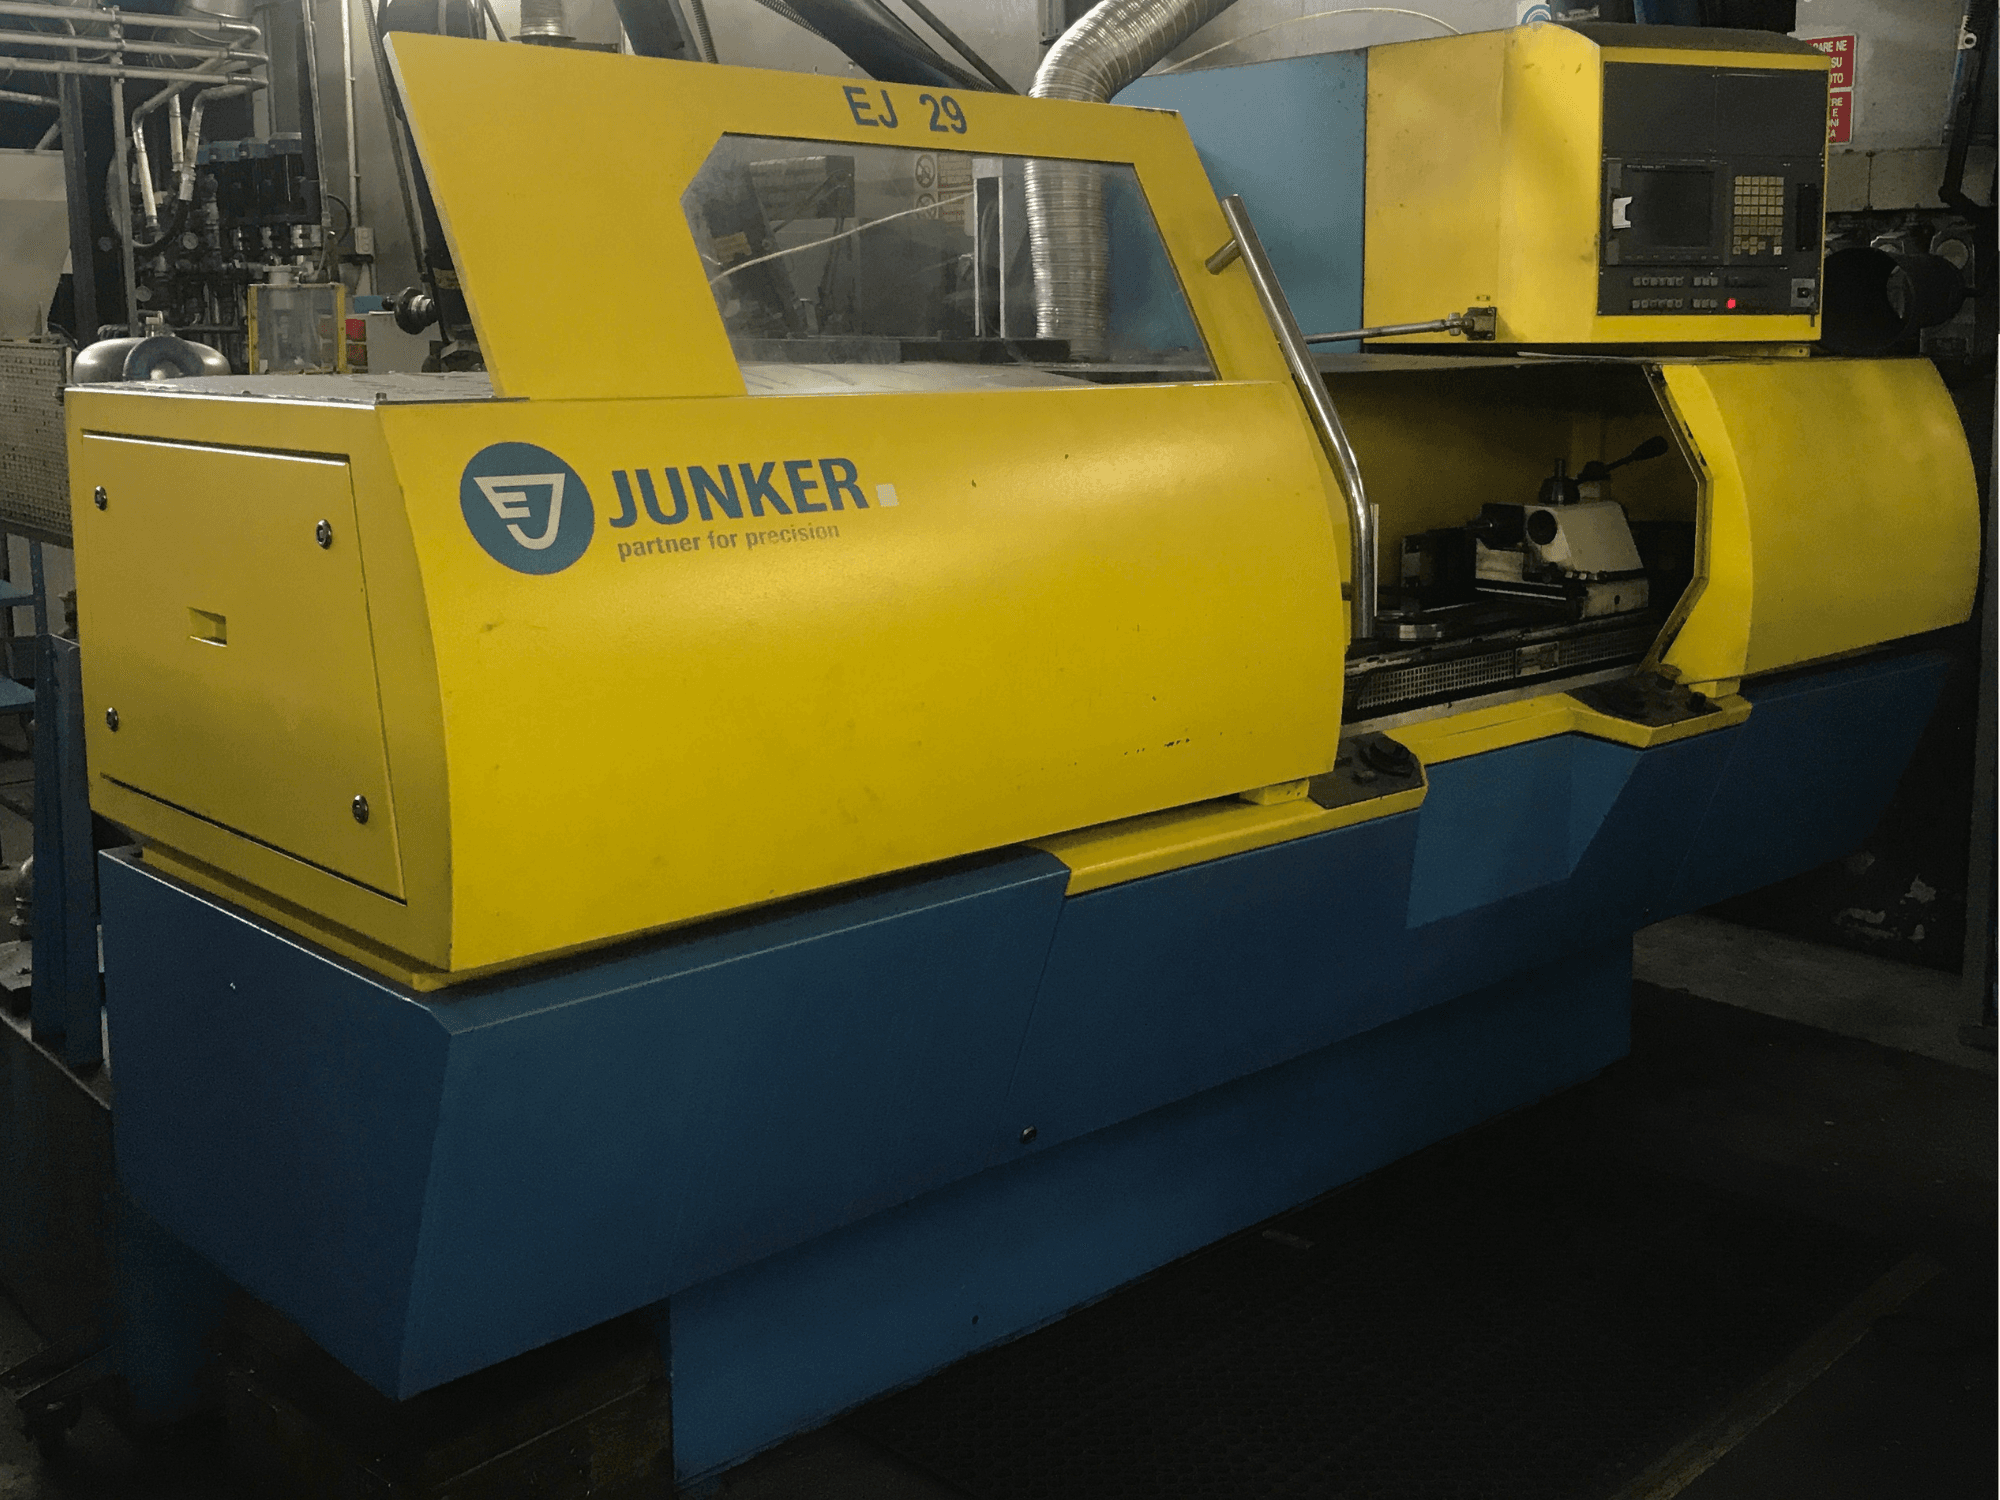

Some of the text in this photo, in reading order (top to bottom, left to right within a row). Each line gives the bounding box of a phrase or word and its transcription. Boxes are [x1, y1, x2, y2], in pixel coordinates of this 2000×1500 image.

[1836, 40, 1847, 51] NE
[1830, 57, 1842, 68] SU
[842, 85, 968, 135] EJ 29
[1830, 97, 1843, 106] RE
[608, 457, 870, 529] JUNKER
[617, 522, 840, 563] partner for precision
